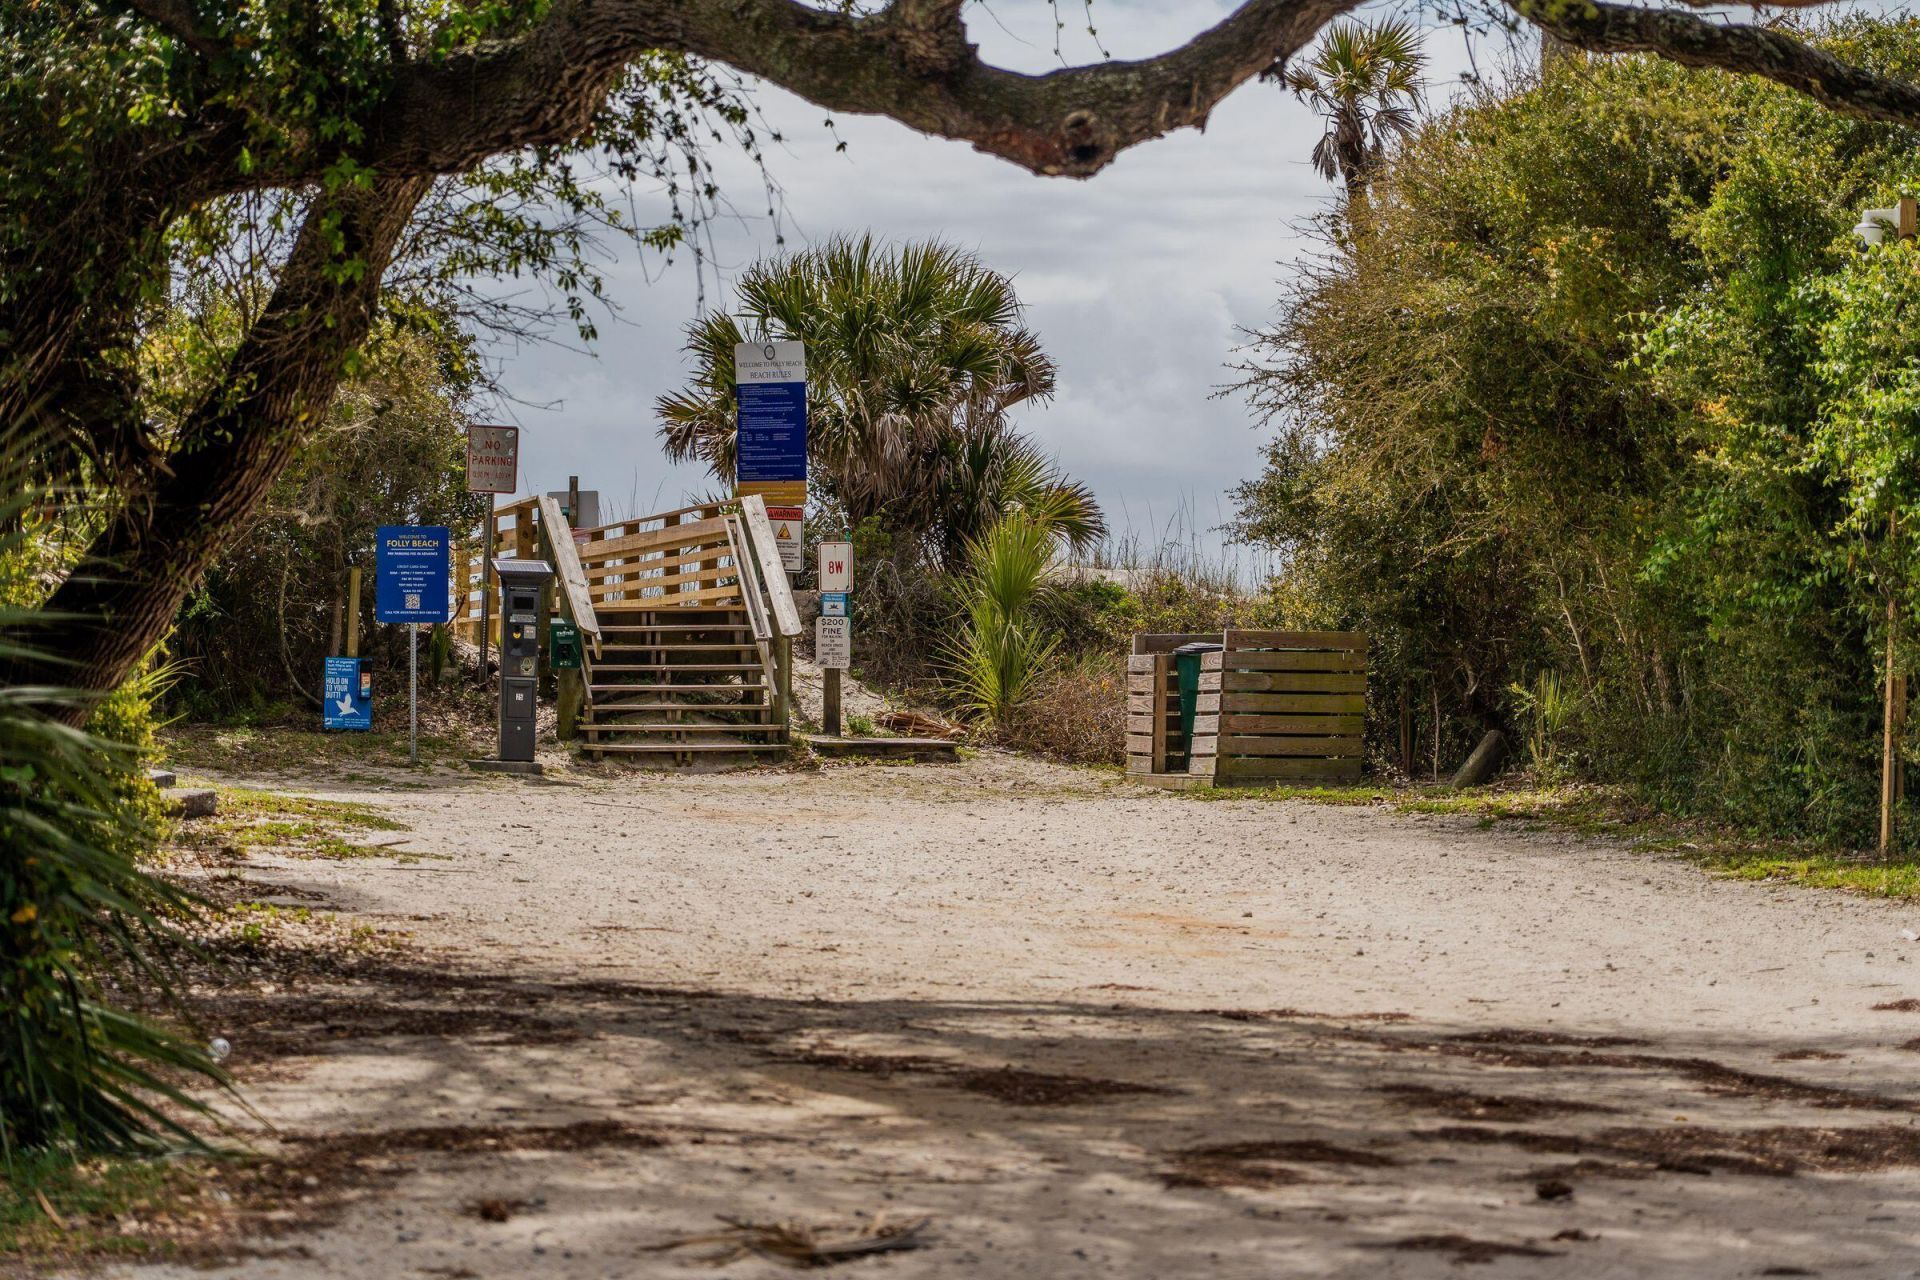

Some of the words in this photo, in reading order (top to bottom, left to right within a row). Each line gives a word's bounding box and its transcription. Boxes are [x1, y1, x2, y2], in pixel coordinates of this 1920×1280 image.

[485, 440, 500, 449] NO
[472, 456, 512, 466] PARKING
[829, 561, 843, 574] 8W
